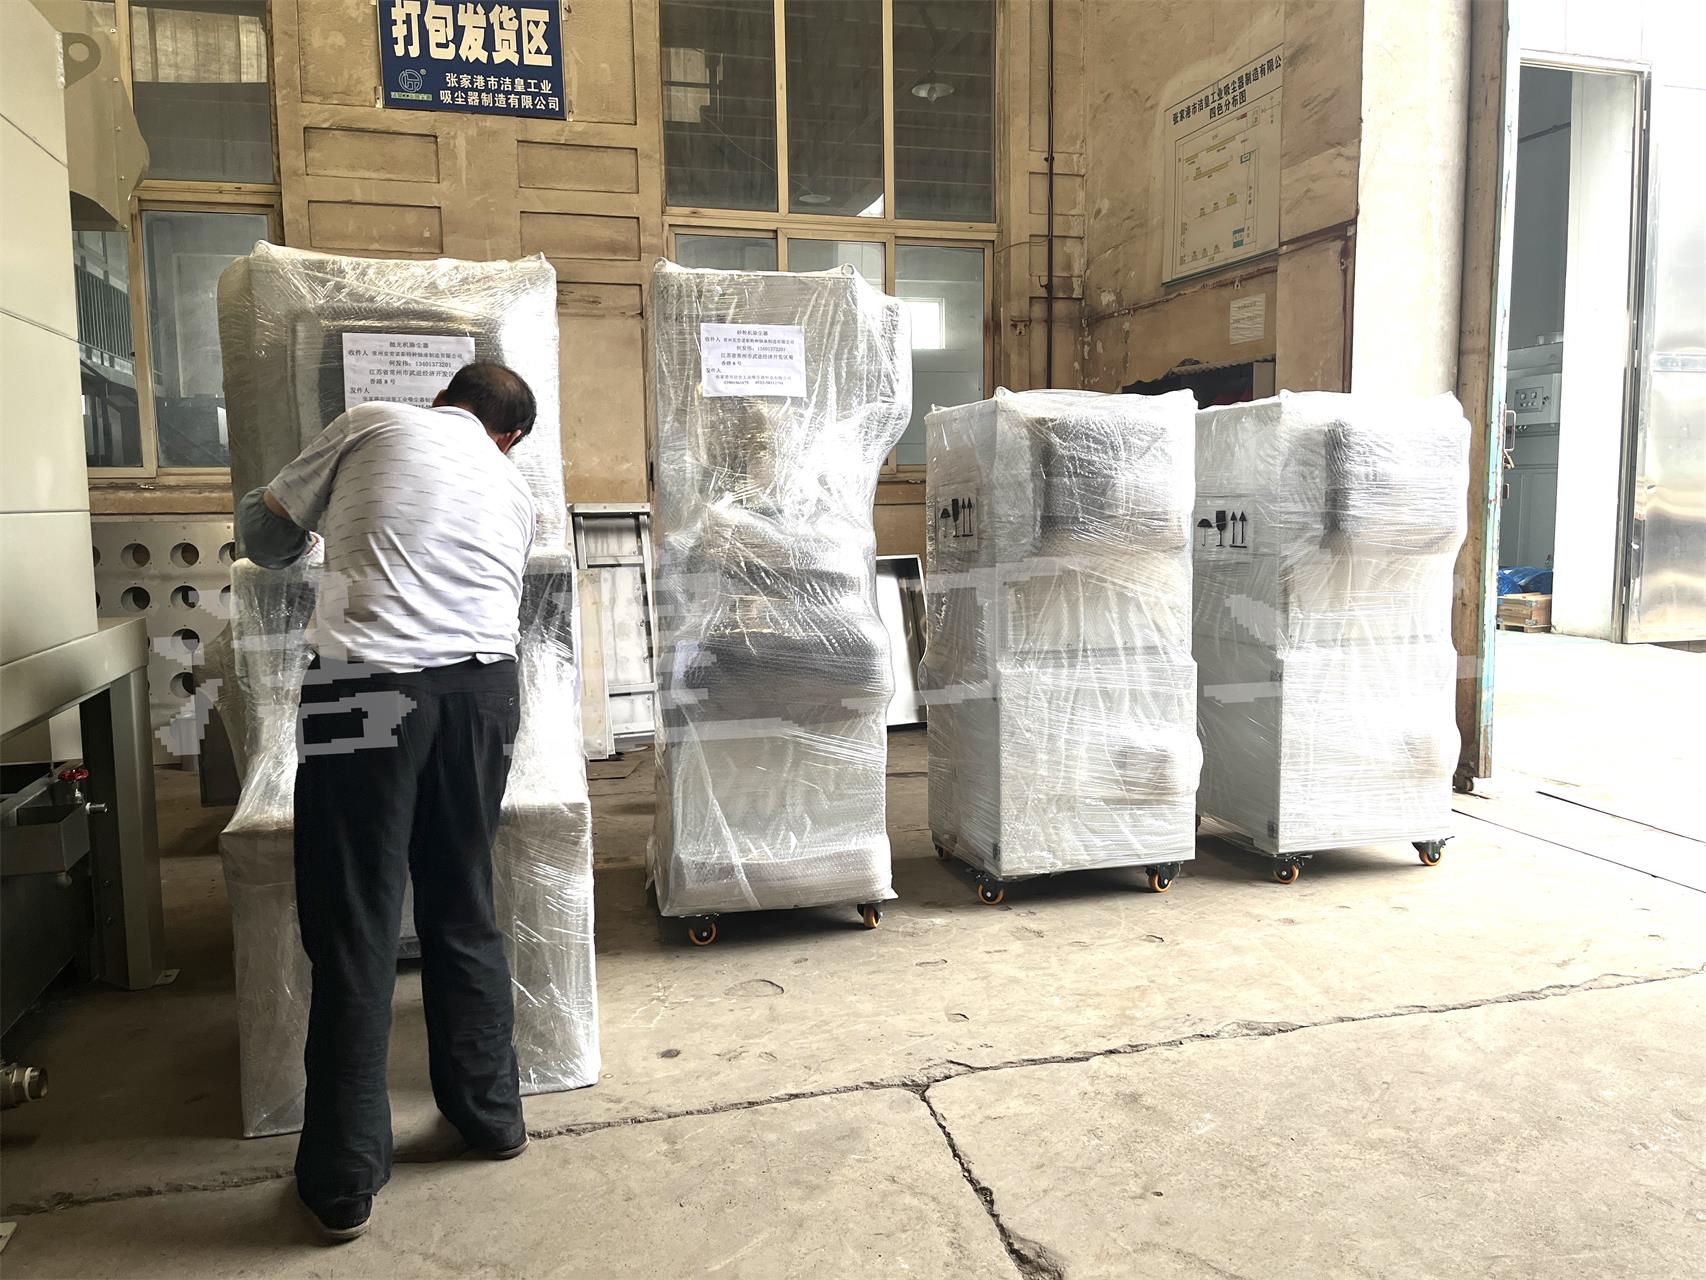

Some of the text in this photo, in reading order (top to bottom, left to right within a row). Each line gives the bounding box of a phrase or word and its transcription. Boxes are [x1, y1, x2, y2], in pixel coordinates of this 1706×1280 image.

[391, 0, 553, 66] 打包发货区
[445, 73, 553, 94] 张家港市洁皇工业
[439, 91, 560, 112] 吸尘器制造有限公司
[1209, 90, 1247, 120] 四色分布图
